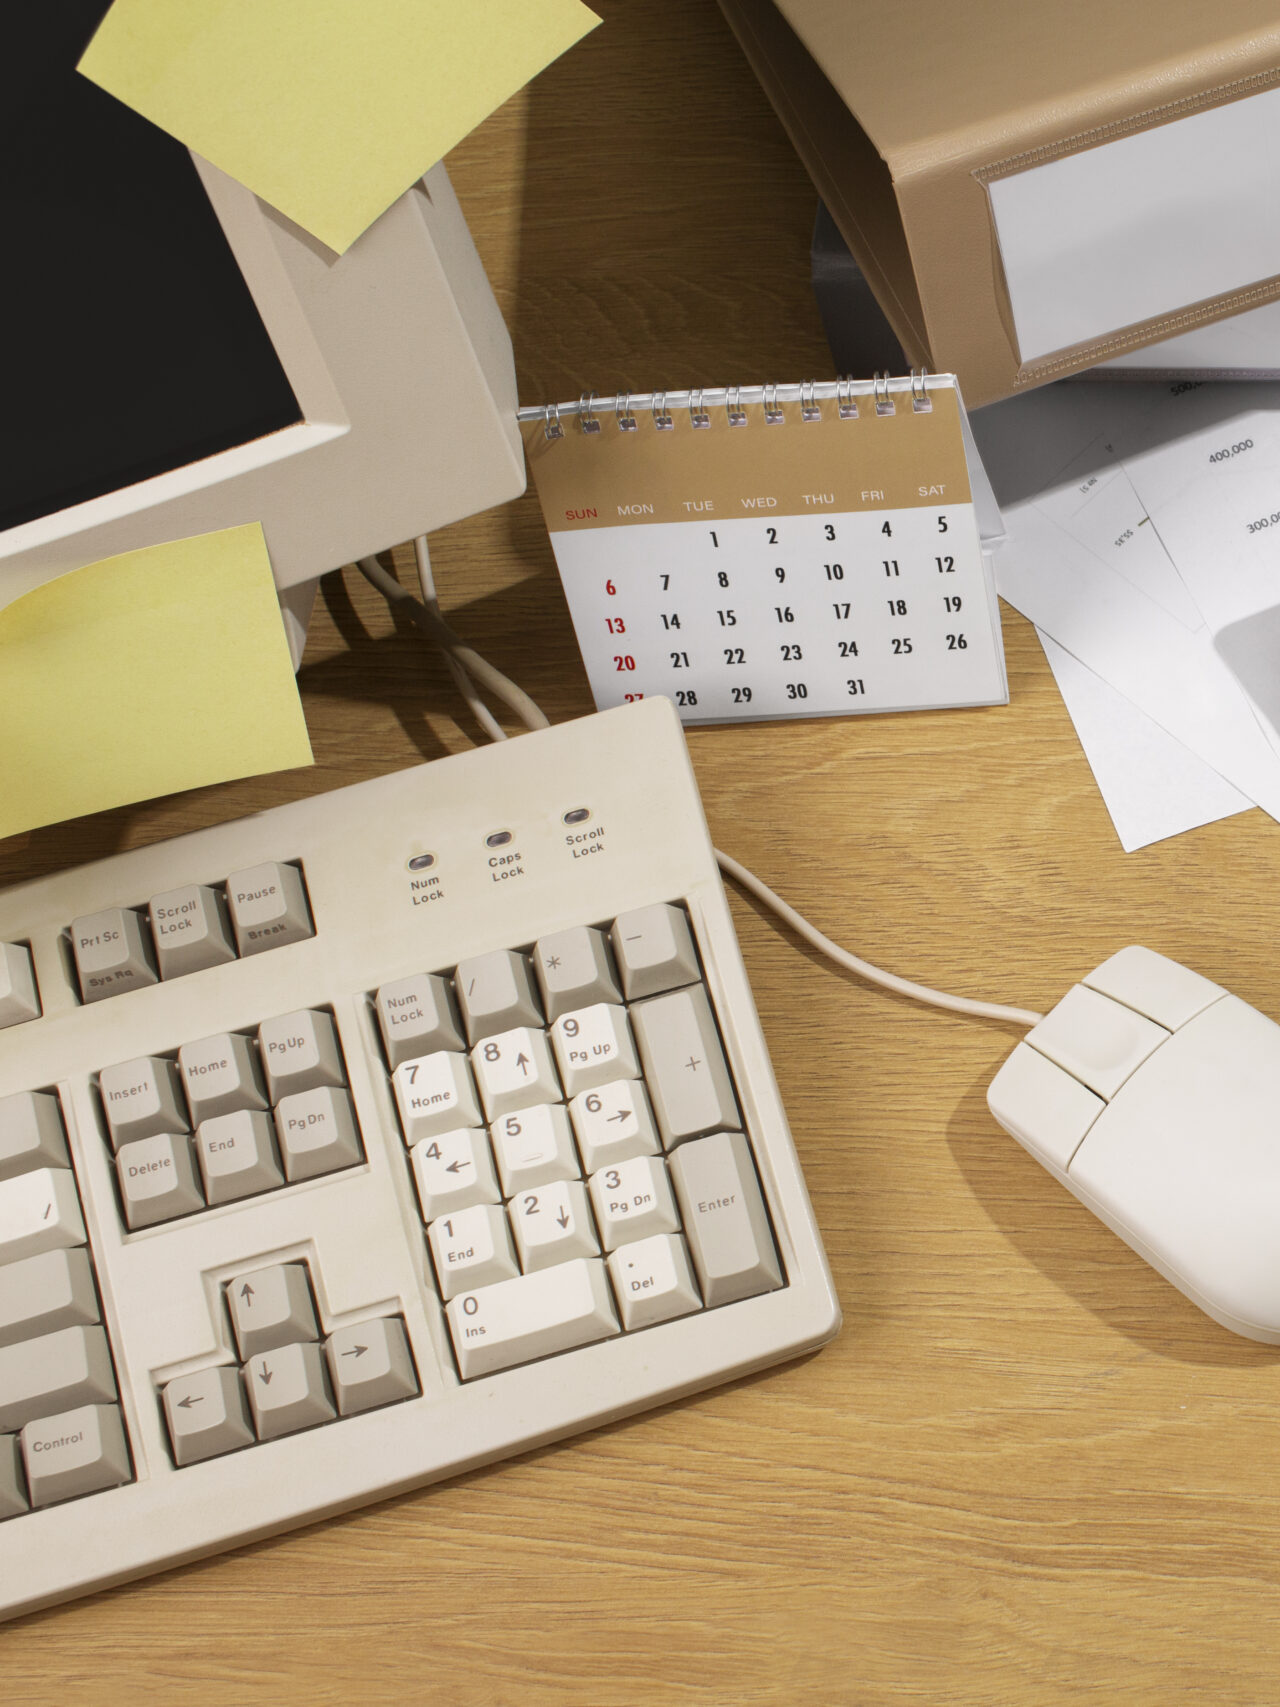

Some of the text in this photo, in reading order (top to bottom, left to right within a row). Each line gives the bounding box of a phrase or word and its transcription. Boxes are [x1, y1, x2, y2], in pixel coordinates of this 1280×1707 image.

[1208, 438, 1254, 464] 400,000
[565, 484, 946, 521] SUN MON TUE WED THU FRI SAT
[709, 515, 948, 548] 1 2 3 4 5
[605, 556, 956, 596] 6 7 8 9 10 11 12
[604, 596, 962, 635] 13 14 15 16 17 18 19
[613, 633, 968, 672] 20 21 22 23 24 25 26
[675, 690, 698, 707] 28
[731, 686, 753, 704] 29
[786, 683, 808, 700] 30
[846, 679, 865, 696] 31
[565, 826, 605, 846] Scroll
[488, 852, 522, 868] Caps
[572, 842, 605, 859] Lock
[410, 876, 440, 891] Num
[491, 866, 525, 883] Lock
[236, 886, 276, 904] Pause
[412, 889, 445, 906] Lock
[156, 899, 197, 920] Scroll
[159, 918, 193, 935] Lock
[247, 923, 287, 940] Break
[102, 931, 120, 943] Sc
[88, 975, 113, 987] Sys
[468, 977, 476, 997] /
[387, 994, 418, 1009] Num
[390, 1008, 424, 1025] Lock
[562, 1018, 580, 1038] 9
[483, 1042, 501, 1063] 8
[569, 1043, 611, 1063] Pg Up
[188, 1059, 228, 1077] Home
[404, 1064, 420, 1085] 7
[108, 1081, 149, 1102] Insert
[410, 1091, 451, 1109] Home
[585, 1093, 603, 1113] 6
[505, 1116, 522, 1137] 5
[208, 1137, 235, 1153] End
[425, 1142, 443, 1161] 4
[128, 1158, 171, 1178] Delete
[605, 1170, 622, 1190] 3
[43, 1203, 52, 1220] /
[523, 1195, 540, 1216] 2
[609, 1194, 651, 1213] Pg Dn
[697, 1194, 736, 1214] Enter
[443, 1219, 454, 1238] 1
[447, 1246, 475, 1263] End
[630, 1276, 655, 1292] Del
[462, 1296, 479, 1316] 0
[465, 1326, 487, 1338] Ins
[32, 1431, 83, 1453] Control
